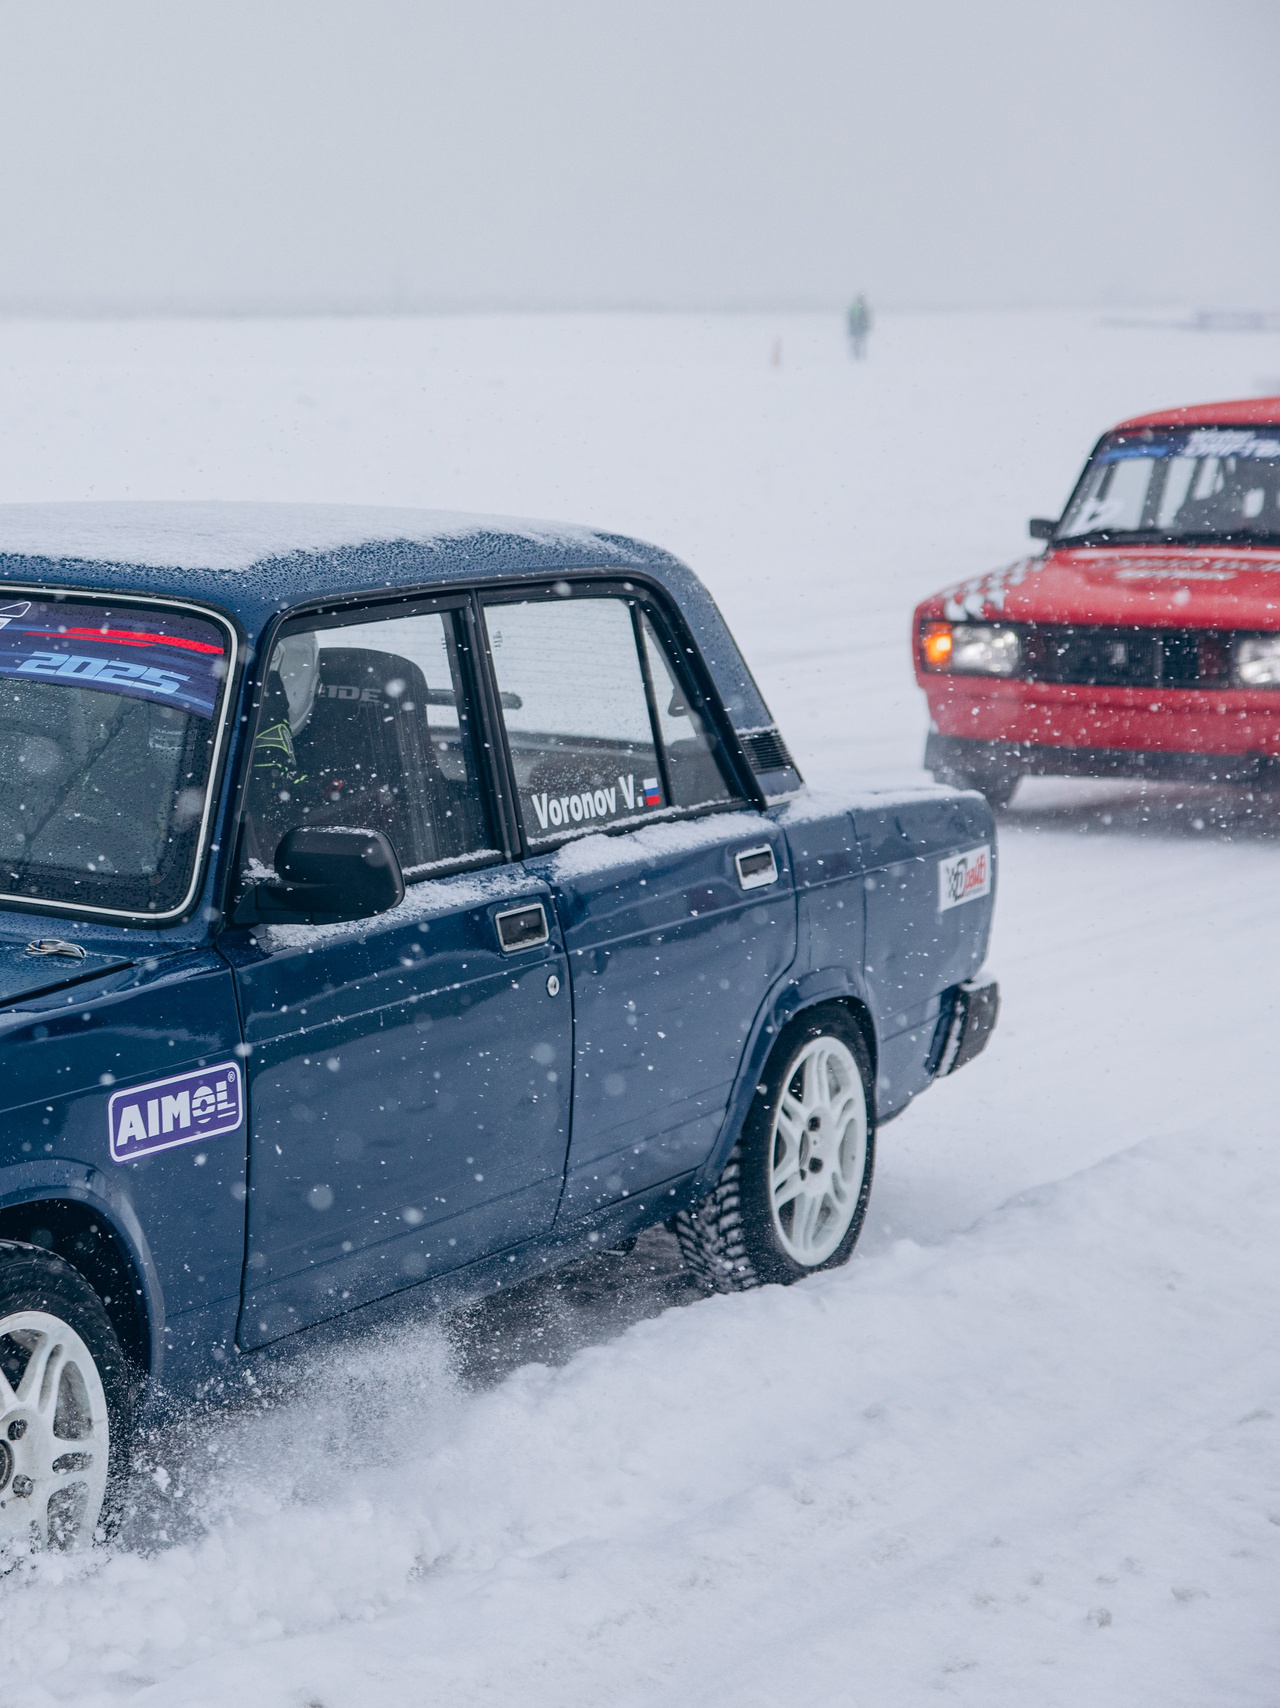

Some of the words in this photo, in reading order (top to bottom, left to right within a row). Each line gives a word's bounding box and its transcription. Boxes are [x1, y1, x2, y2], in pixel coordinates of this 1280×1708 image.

[17, 651, 191, 694] 2025
[531, 787, 616, 829] Voronov
[618, 774, 644, 809] V.
[116, 1080, 236, 1147] AIMOL
